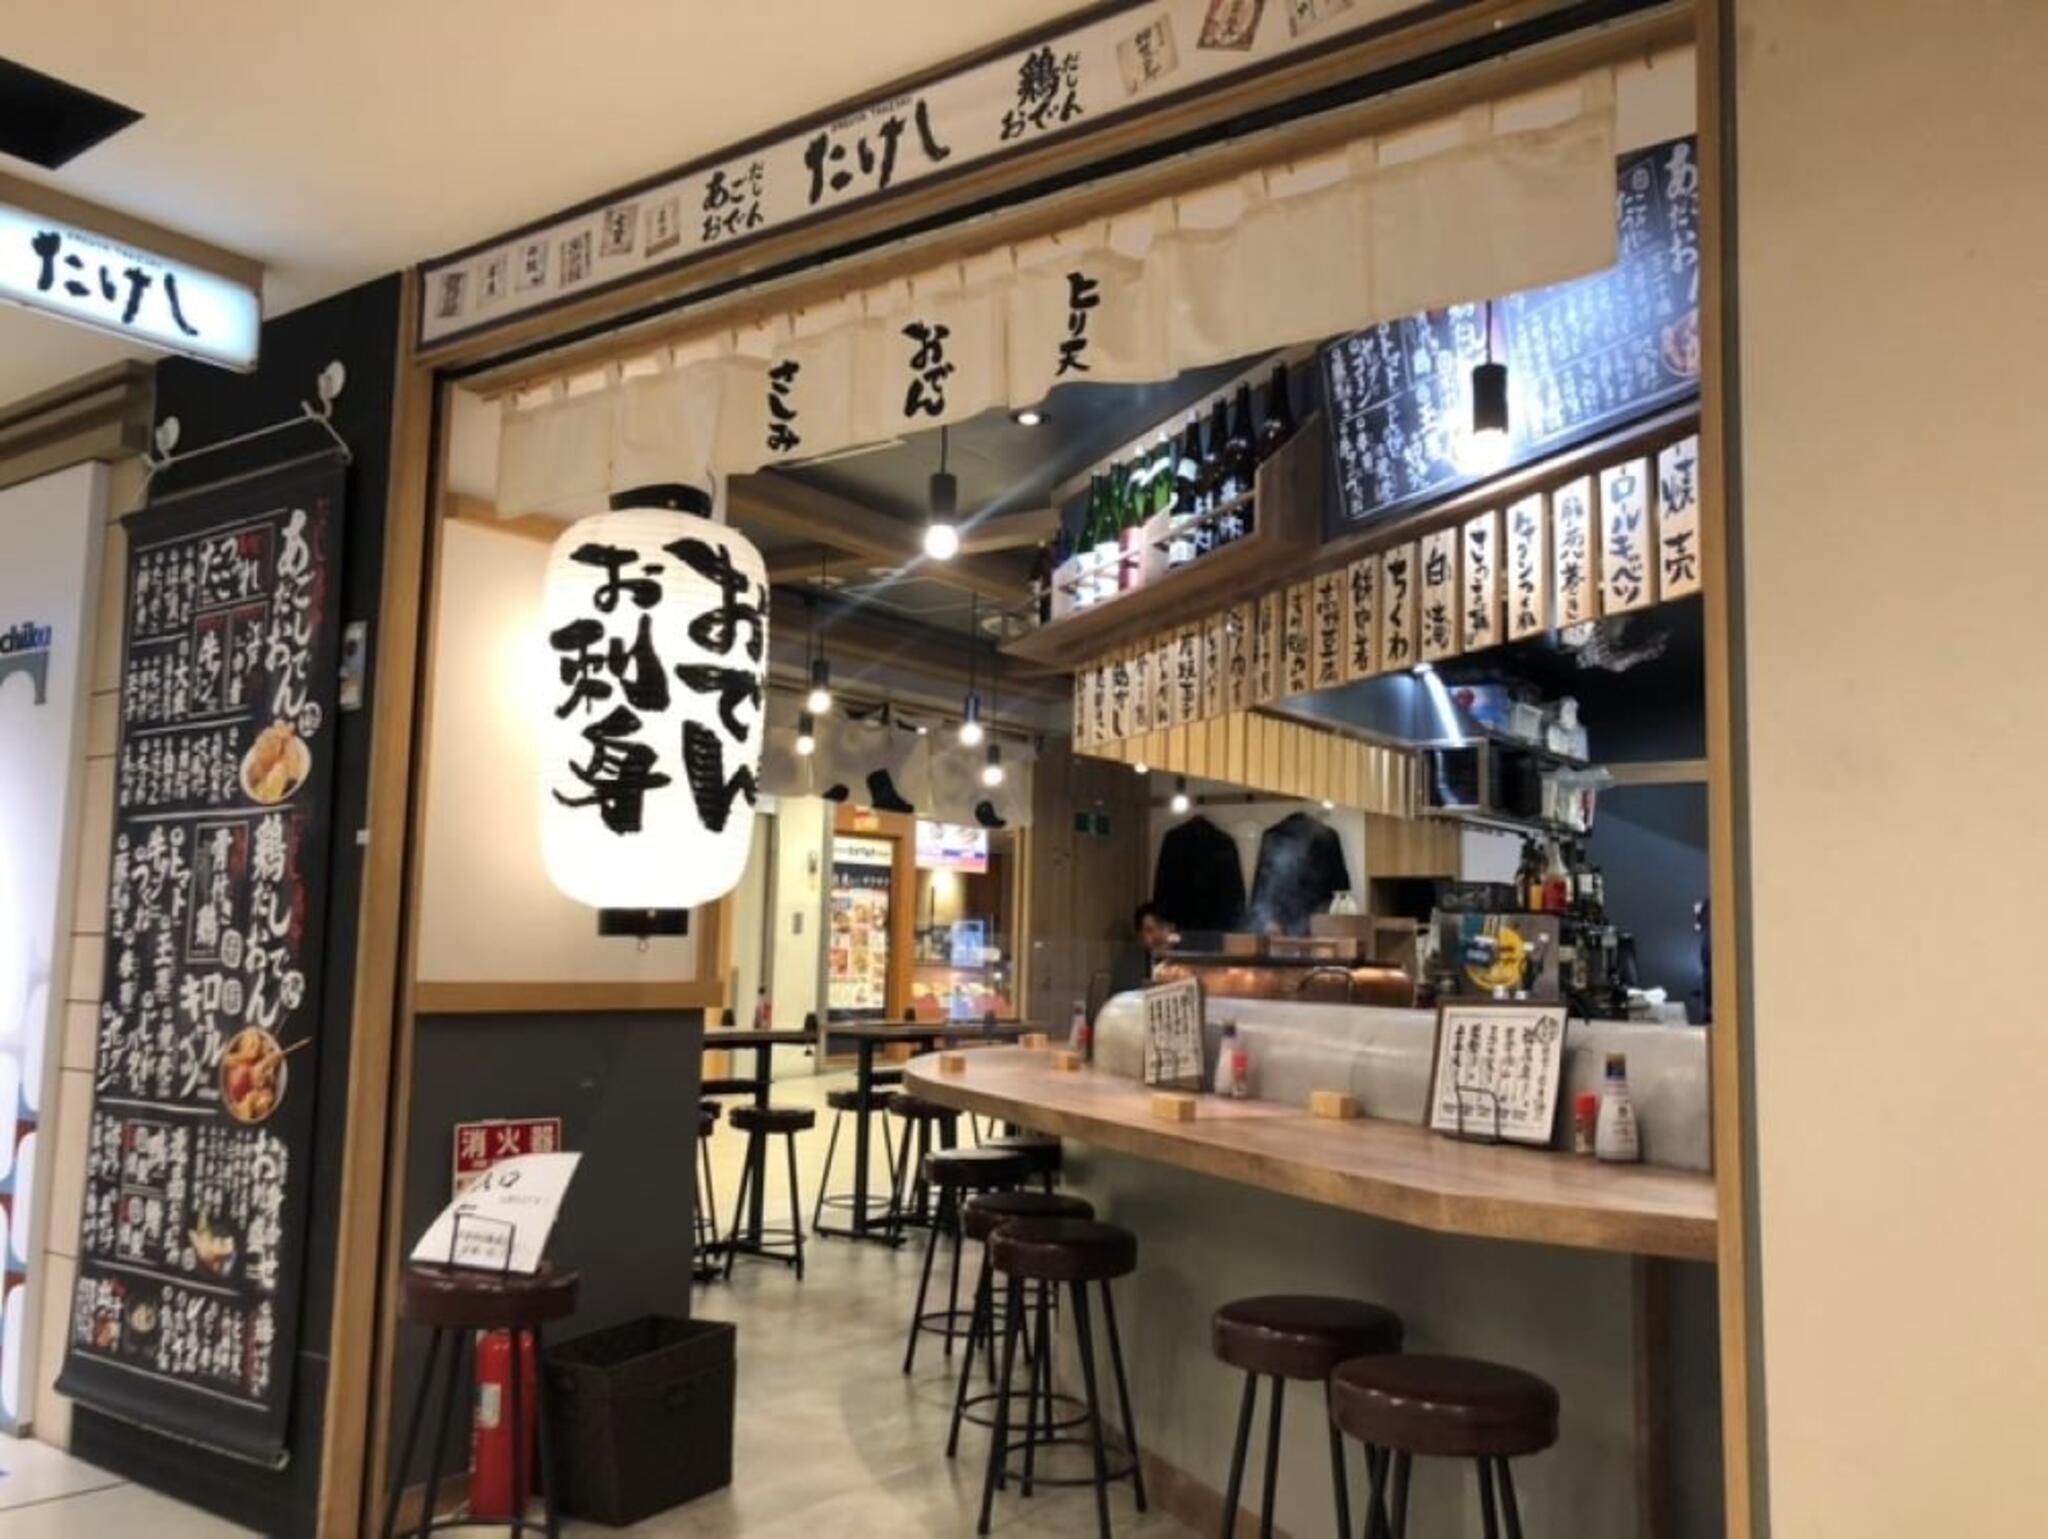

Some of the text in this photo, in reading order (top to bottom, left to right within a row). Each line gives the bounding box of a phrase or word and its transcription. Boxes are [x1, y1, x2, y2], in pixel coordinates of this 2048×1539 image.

[804, 98, 951, 206] たけし
[1000, 92, 1084, 140] おでん
[702, 206, 765, 242] おでん
[32, 230, 199, 337] たけし
[1055, 272, 1100, 376] とり天
[767, 359, 800, 453] さしみ
[903, 321, 954, 417] おでん
[1387, 558, 1409, 661] ちくわ
[549, 543, 673, 835] お刺身
[662, 537, 770, 834] おでん
